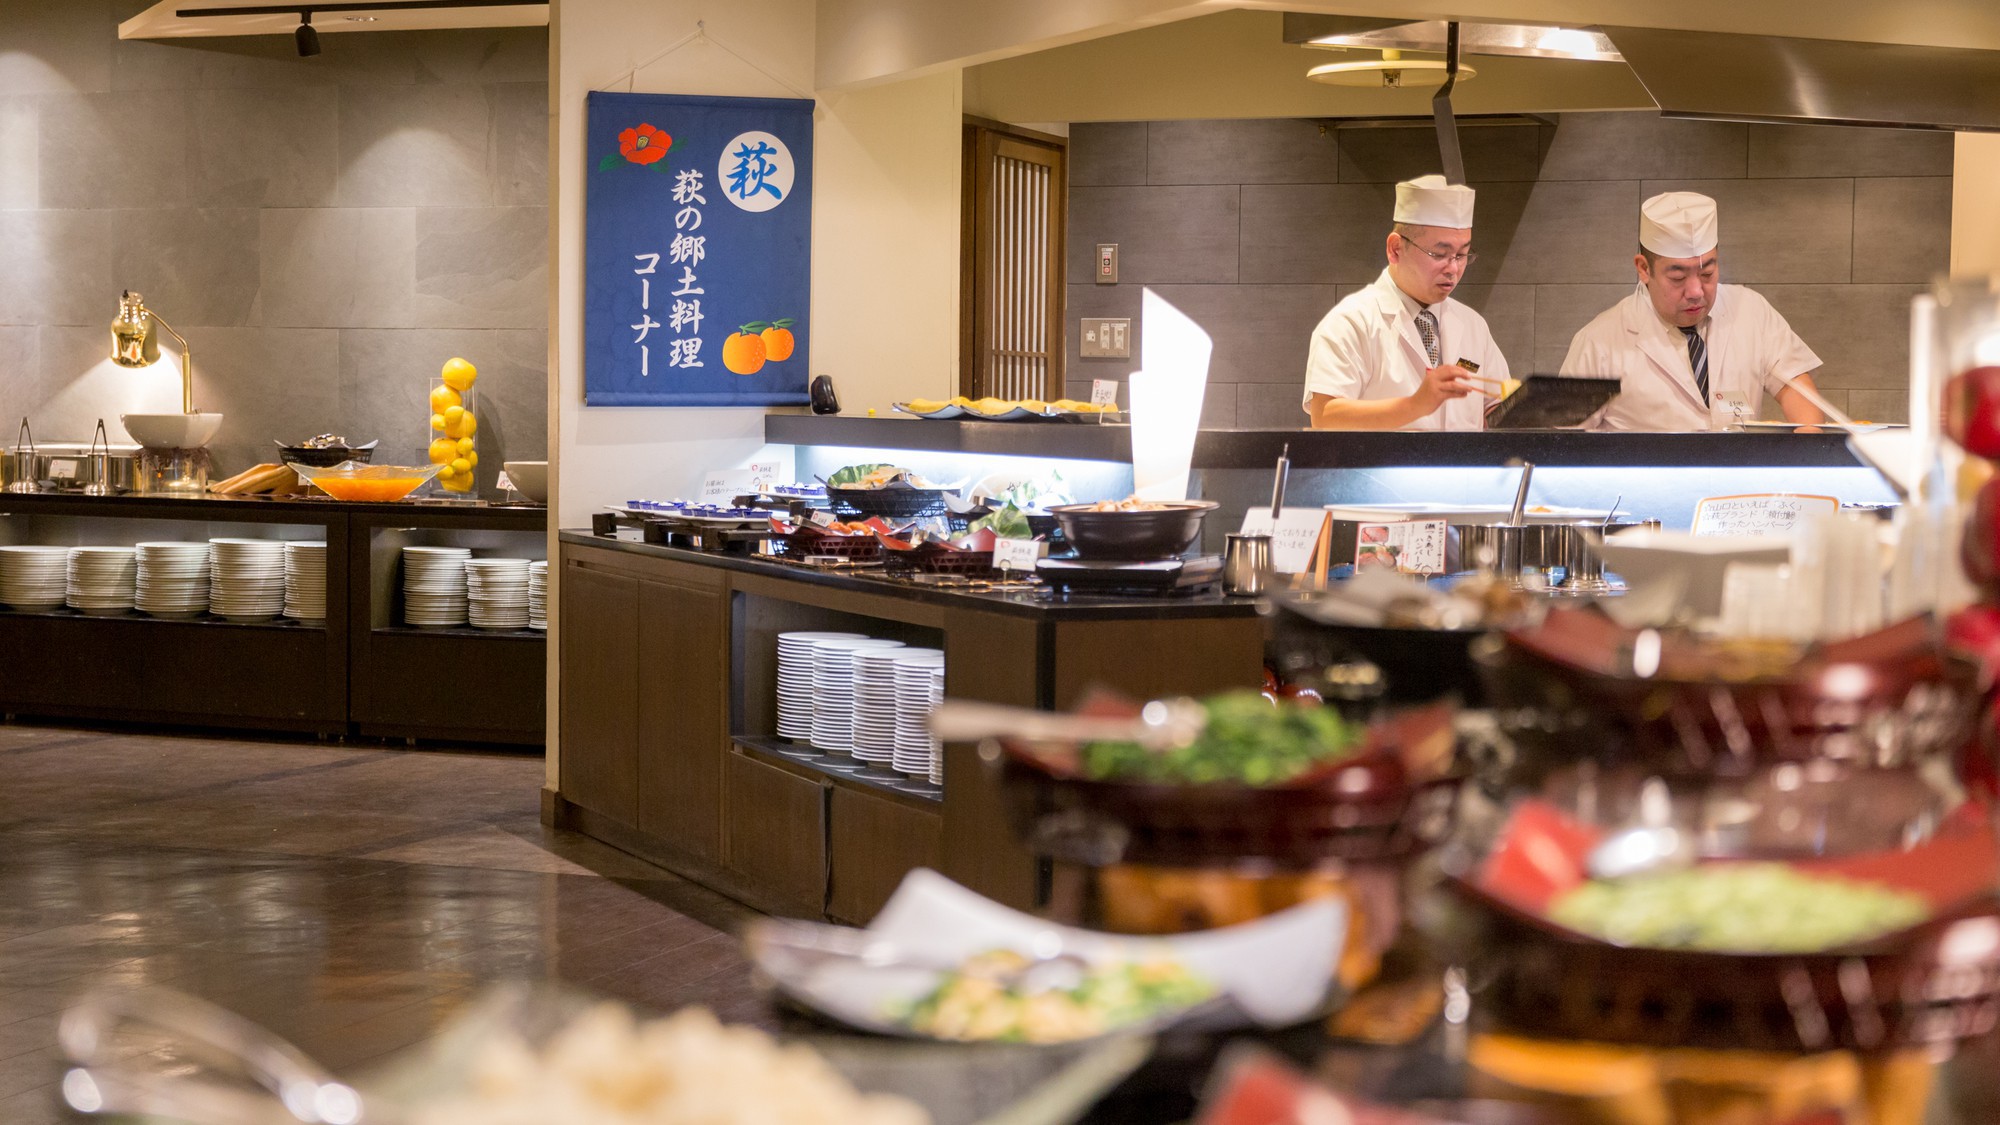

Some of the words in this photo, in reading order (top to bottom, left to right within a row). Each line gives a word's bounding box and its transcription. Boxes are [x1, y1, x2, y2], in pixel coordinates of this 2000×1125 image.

[726, 141, 783, 201] 萩
[630, 252, 661, 377] コーナー
[668, 169, 707, 369] 萩の郷土料理
